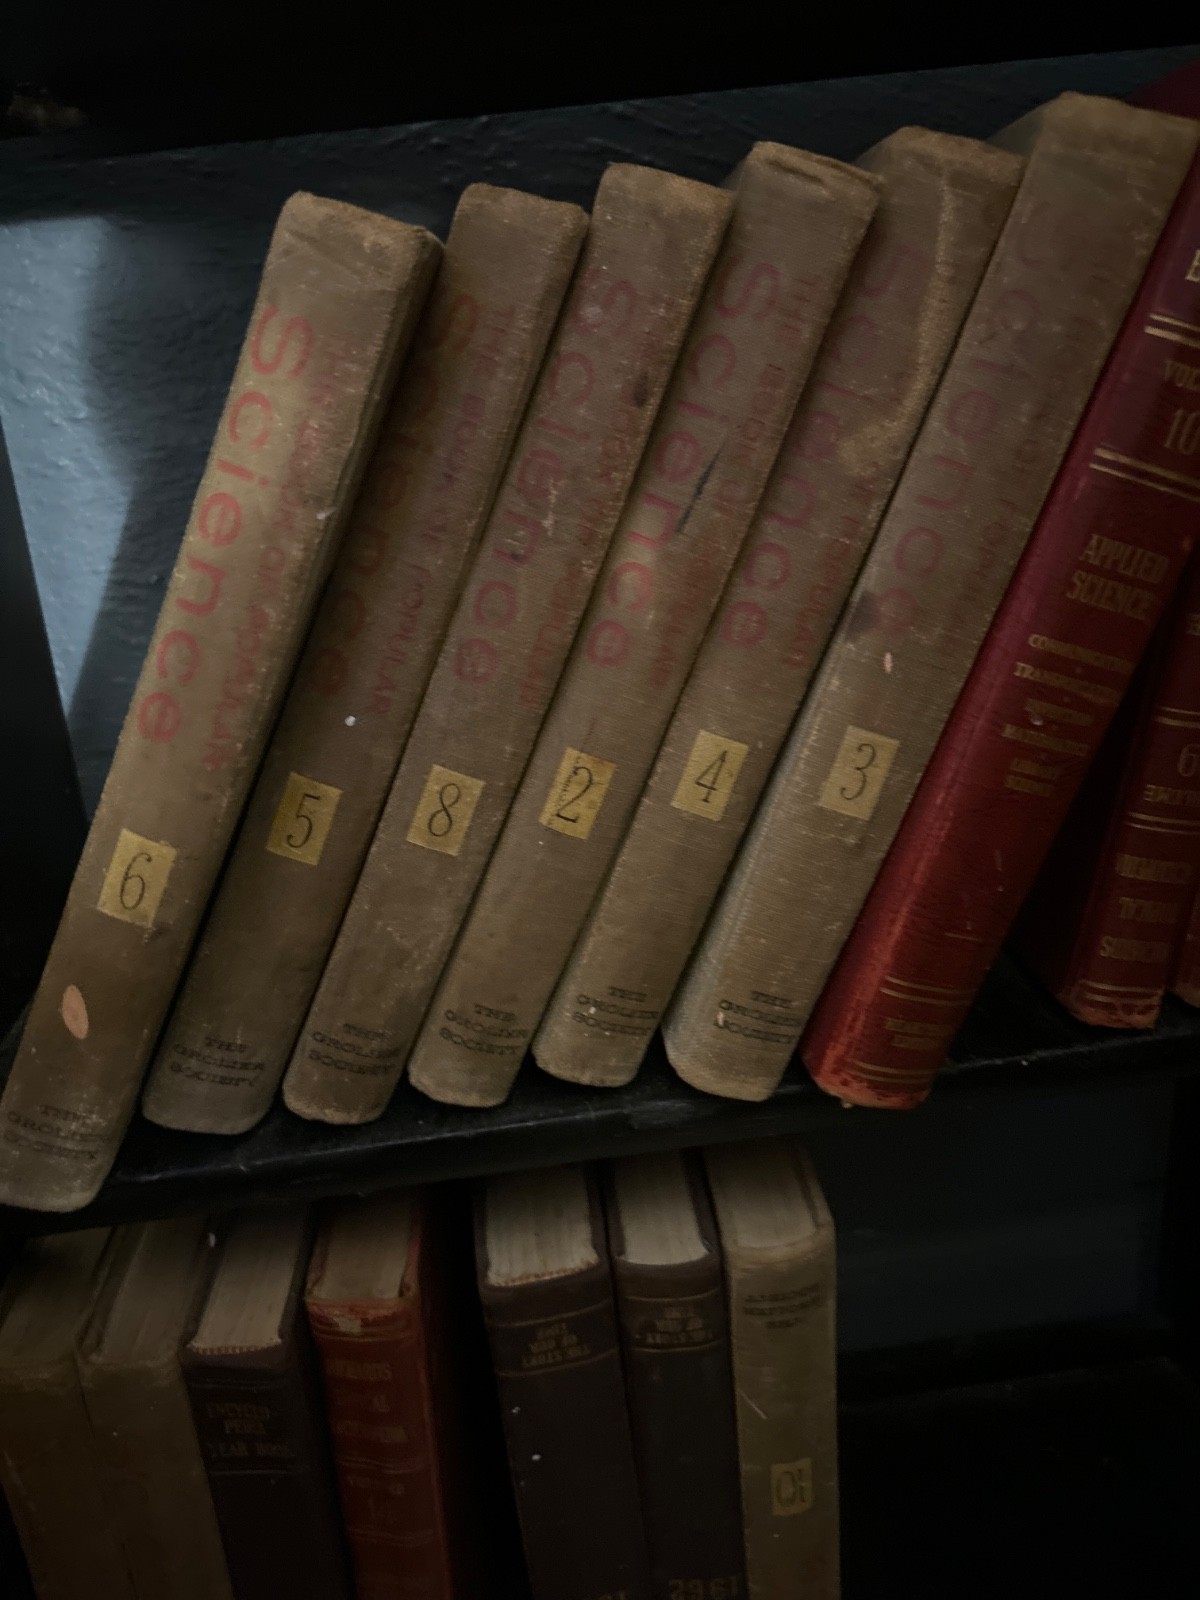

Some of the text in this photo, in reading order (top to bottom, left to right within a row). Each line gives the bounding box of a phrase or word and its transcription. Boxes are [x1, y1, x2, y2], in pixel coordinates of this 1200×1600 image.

[454, 274, 633, 684] Science
[587, 258, 778, 668] Science
[311, 292, 475, 695] Science
[137, 312, 312, 741] Science
[1079, 533, 1169, 584] APPLIED
[366, 563, 434, 717] POPULAR
[556, 766, 593, 823] 2
[695, 751, 727, 803] 4
[840, 743, 876, 801] 3
[287, 793, 320, 848] 5
[428, 783, 460, 837] 8
[120, 851, 151, 909] 6
[474, 1004, 516, 1022] THE
[577, 994, 659, 1020] GROLIER
[609, 986, 648, 1002] THE
[719, 999, 801, 1026] GROLIER
[751, 990, 793, 1008] THE
[204, 1036, 249, 1055] THE
[445, 1009, 529, 1039] GROLIER
[173, 1043, 265, 1072] GROLIER
[775, 1467, 806, 1505] 10
